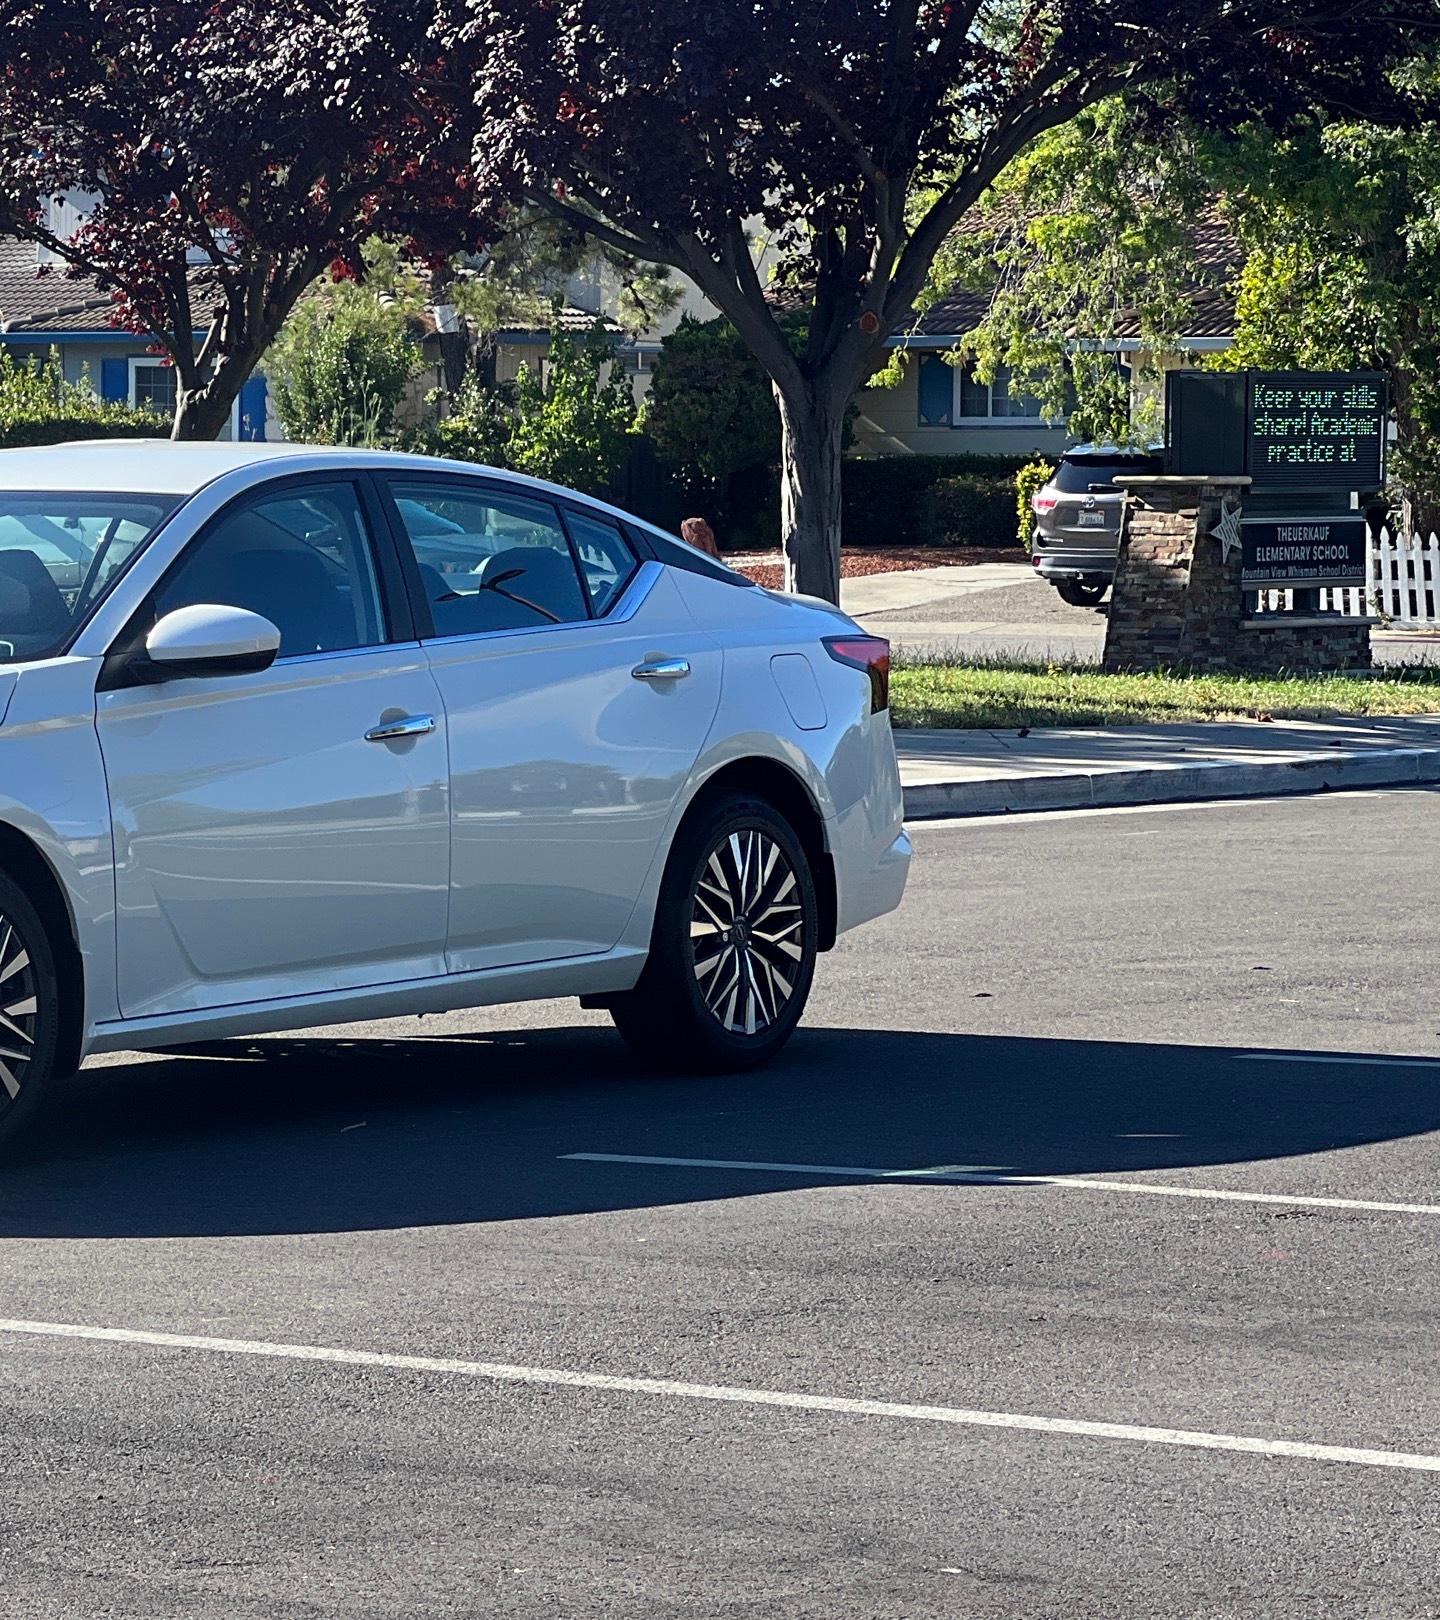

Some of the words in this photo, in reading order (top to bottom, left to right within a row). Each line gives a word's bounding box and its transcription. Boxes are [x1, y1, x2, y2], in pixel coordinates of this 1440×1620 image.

[1254, 384, 1294, 408] Keep
[1298, 390, 1338, 408] your
[1342, 384, 1377, 409] skills
[1253, 411, 1307, 435] sharp!
[1311, 411, 1378, 435] Academic
[1268, 438, 1335, 462] practice
[1339, 438, 1357, 462] at
[1277, 526, 1330, 542] THEUERKAUF
[1256, 546, 1311, 562] ELEMENTARY
[1312, 545, 1350, 560] SCHOOL
[1270, 566, 1286, 578] View
[1287, 565, 1317, 578] Whisman
[1318, 564, 1340, 577] School
